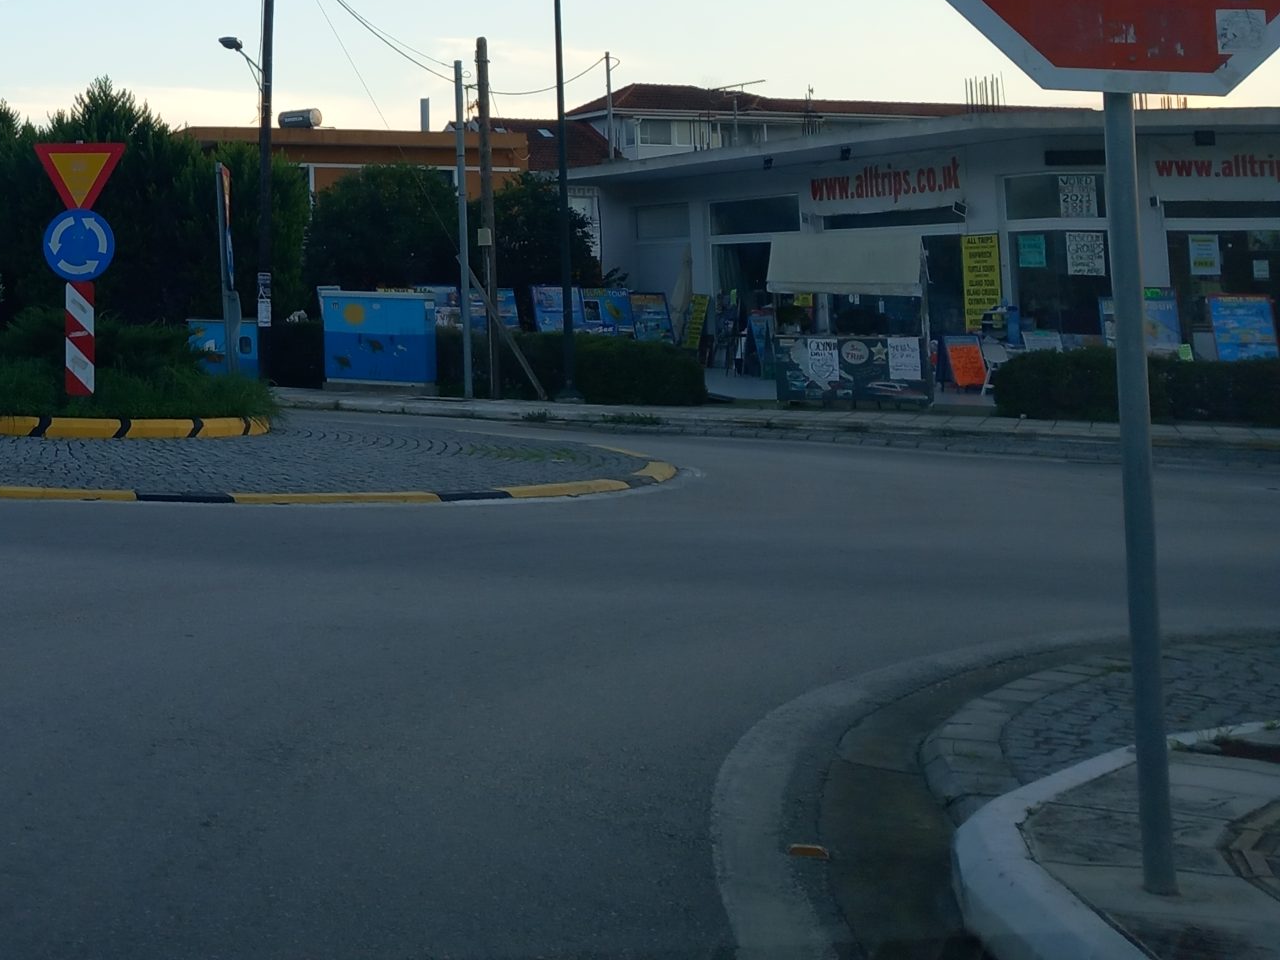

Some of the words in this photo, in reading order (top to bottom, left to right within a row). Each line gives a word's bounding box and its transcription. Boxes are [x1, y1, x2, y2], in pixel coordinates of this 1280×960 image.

[811, 156, 960, 203] www.alltrips.co.uk
[1062, 193, 1092, 202] 2021
[967, 237, 977, 245] ALL
[978, 236, 993, 244] TRIPS
